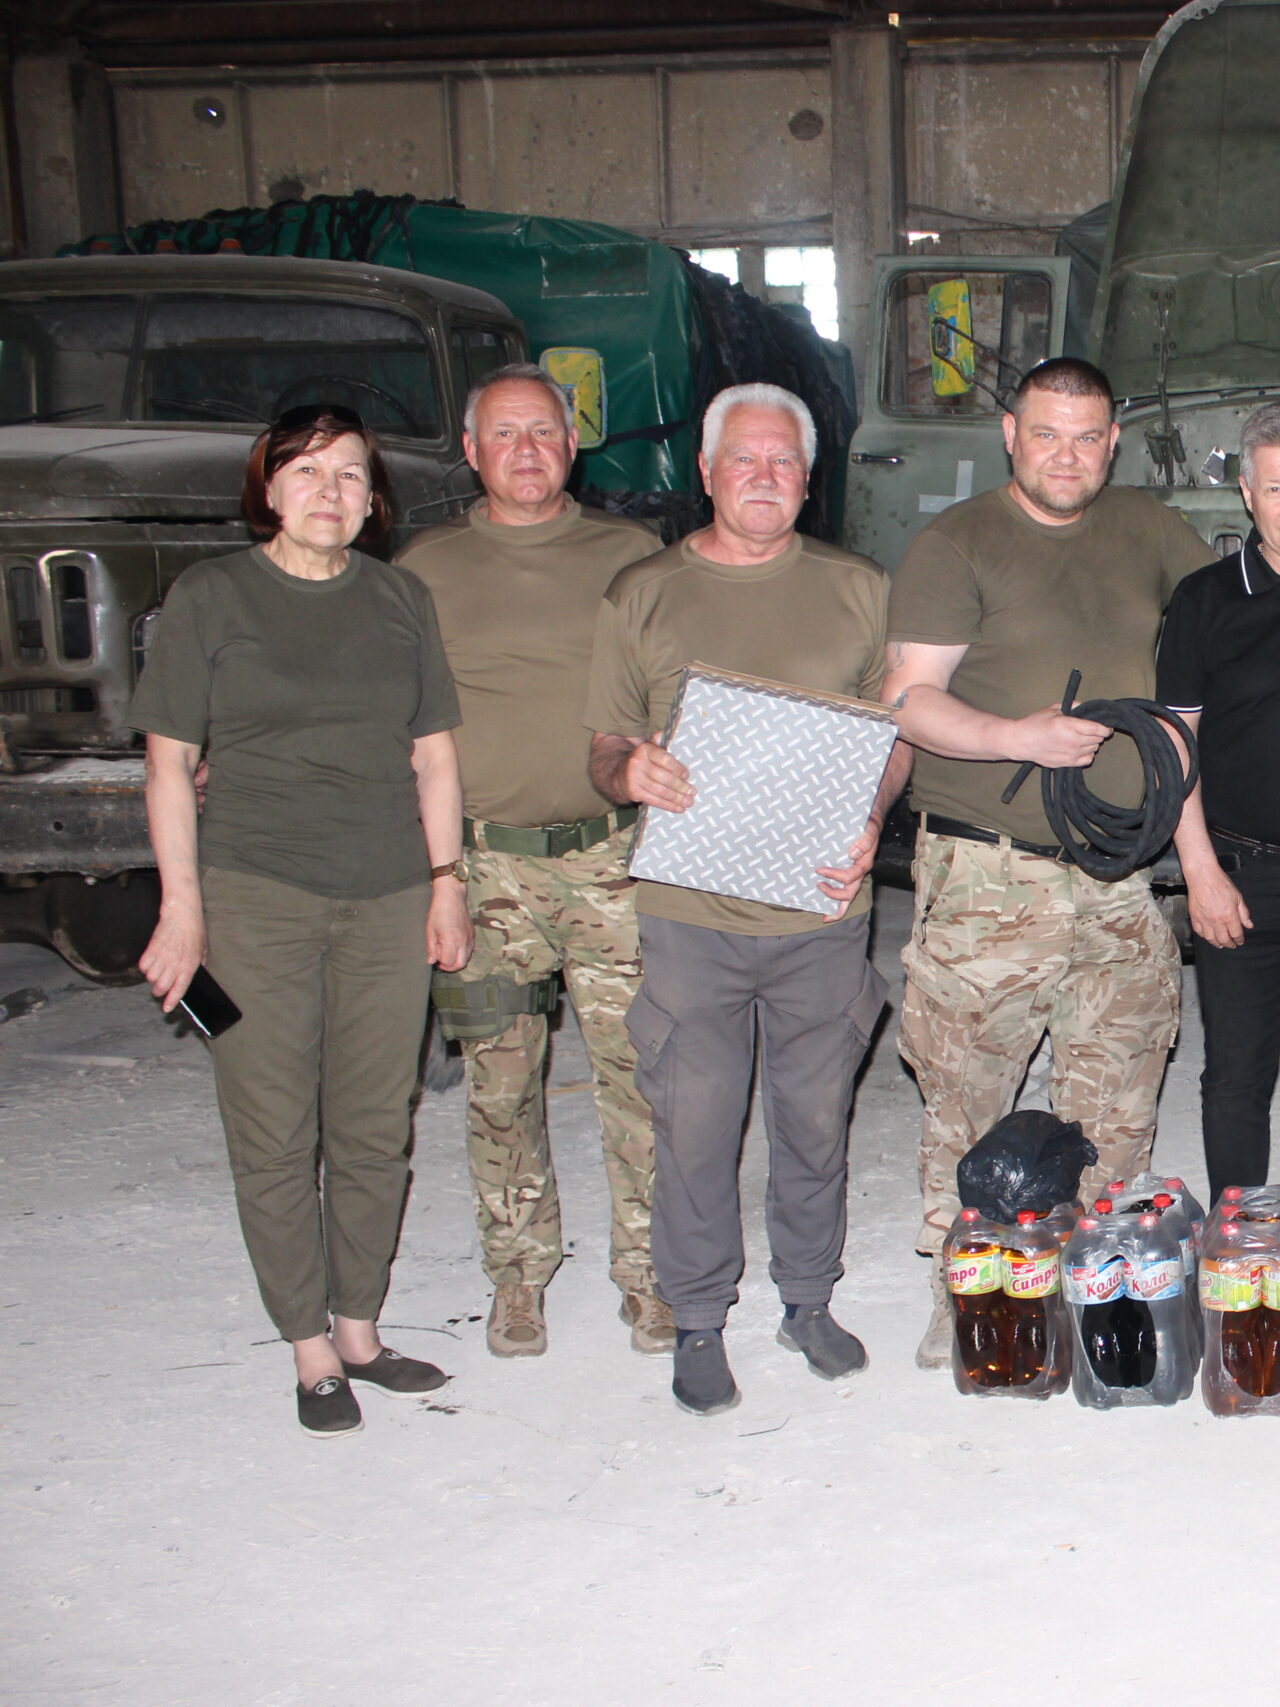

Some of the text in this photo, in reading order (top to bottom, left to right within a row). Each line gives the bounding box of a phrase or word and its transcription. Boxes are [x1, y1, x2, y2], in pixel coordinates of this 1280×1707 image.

[1012, 1264, 1058, 1292] Ситро
[1086, 1272, 1120, 1297] Кола
[1132, 1272, 1167, 1293] Кола
